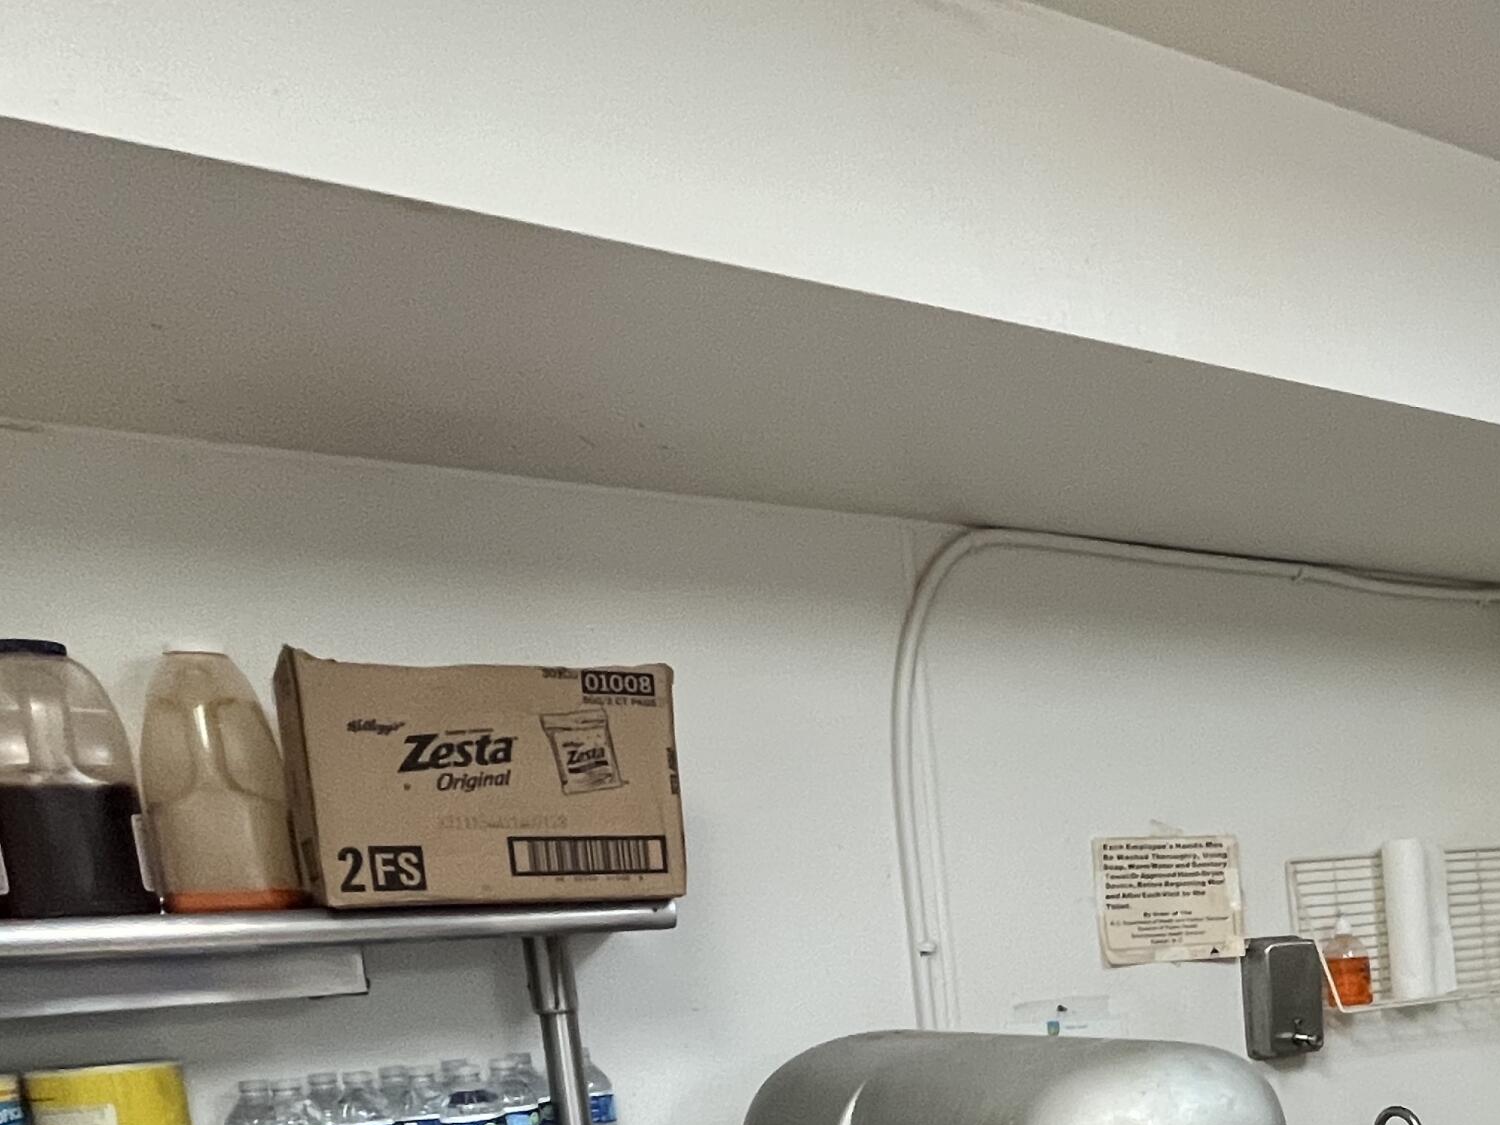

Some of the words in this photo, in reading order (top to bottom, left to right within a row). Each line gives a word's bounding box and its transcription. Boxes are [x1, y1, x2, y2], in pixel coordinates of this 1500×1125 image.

[584, 673, 652, 693] 01008
[397, 733, 514, 773] Zesta
[436, 769, 512, 793] Original
[337, 847, 366, 893] 2
[374, 851, 422, 888] FS
